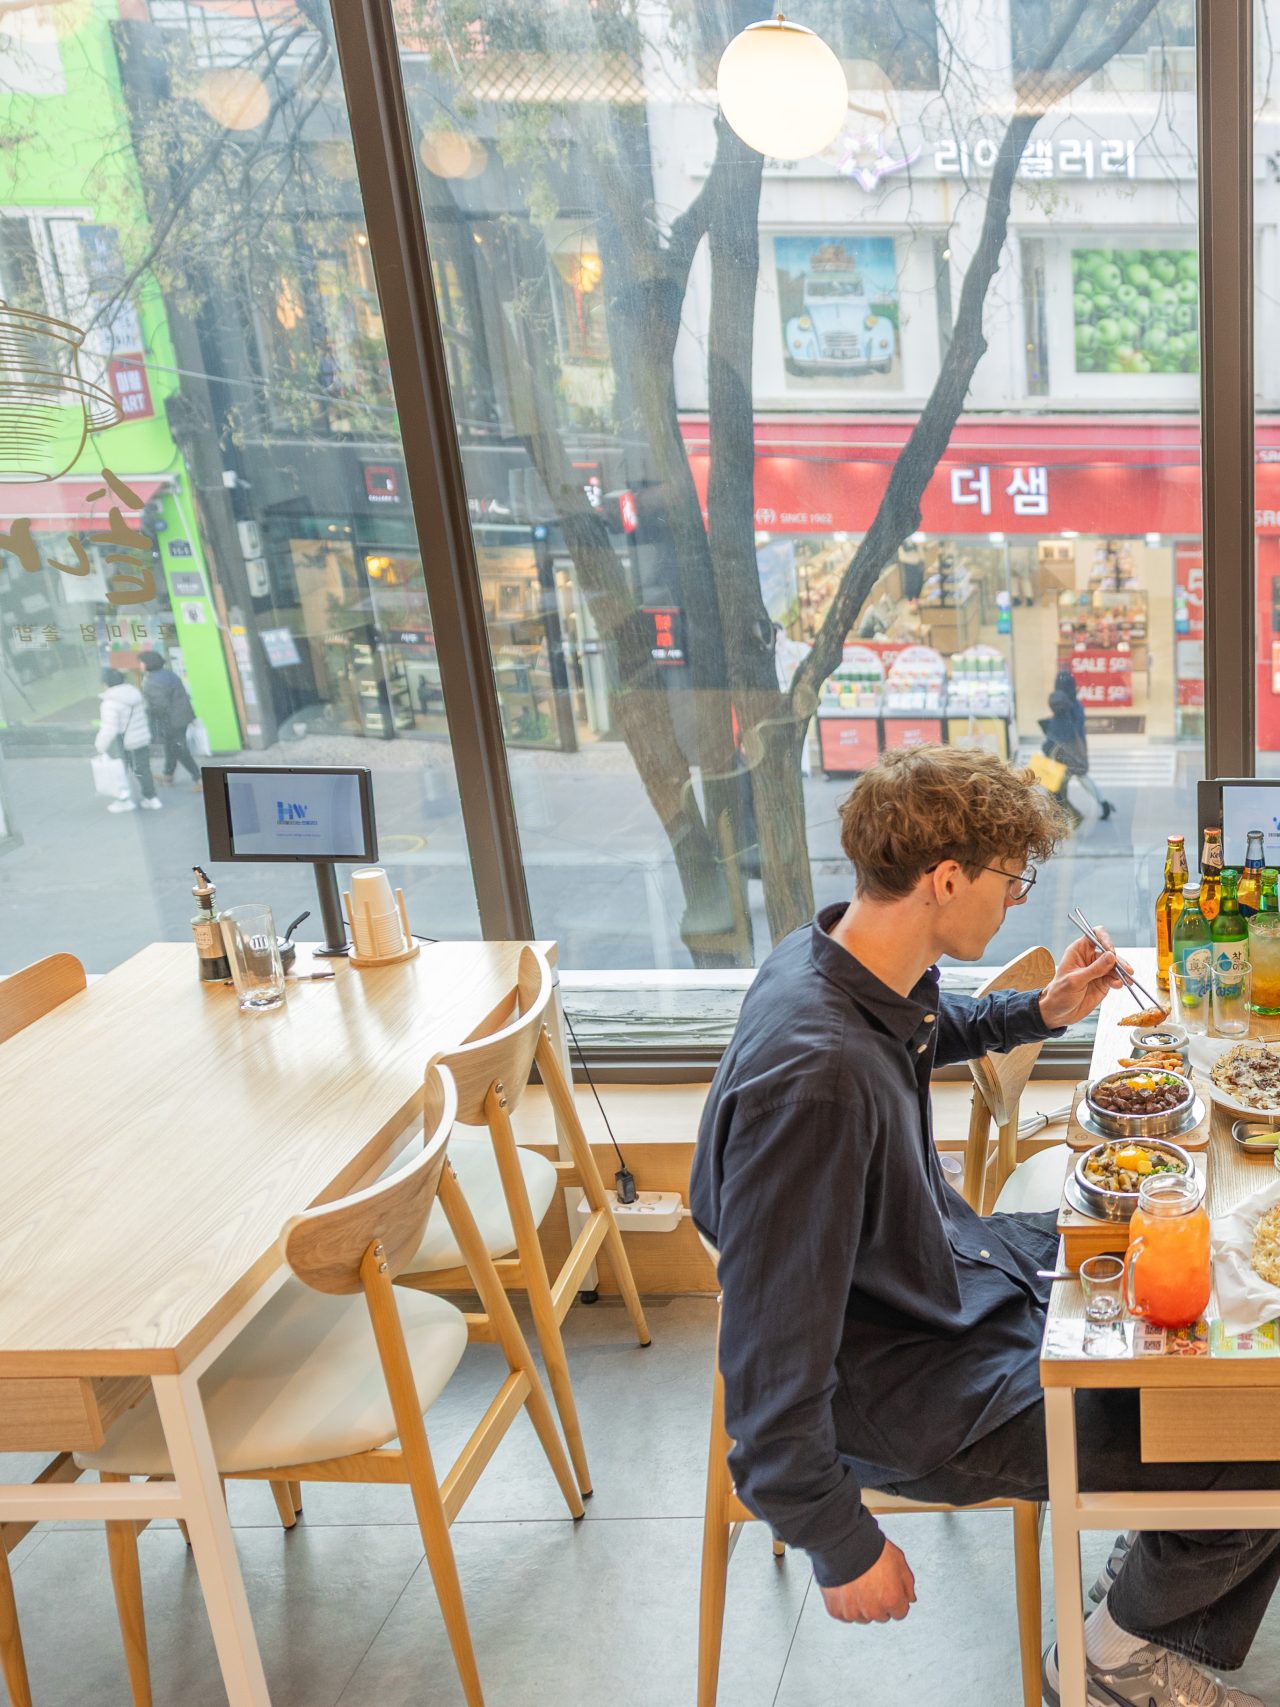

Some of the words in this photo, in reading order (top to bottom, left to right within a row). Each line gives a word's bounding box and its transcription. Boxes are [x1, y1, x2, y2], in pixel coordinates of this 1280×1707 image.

[121, 394, 146, 413] ART
[1072, 657, 1106, 673] SALE
[1076, 685, 1104, 701] ALE
